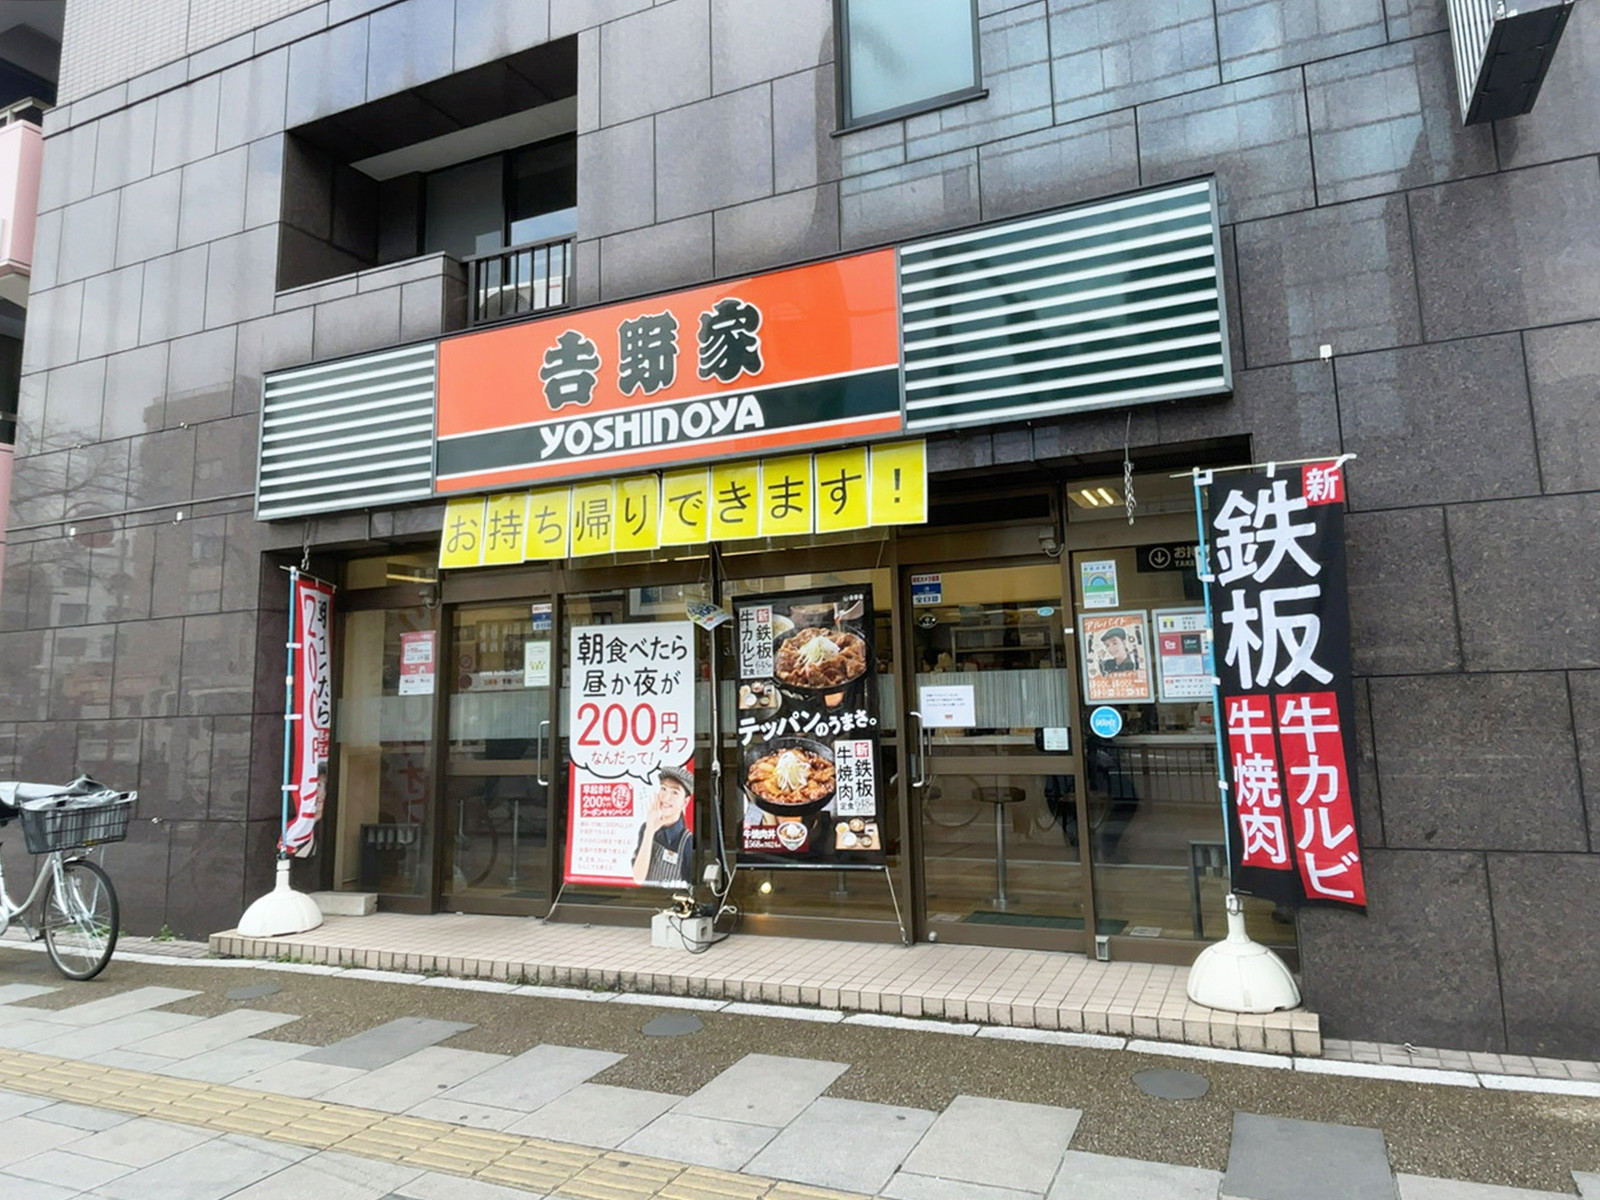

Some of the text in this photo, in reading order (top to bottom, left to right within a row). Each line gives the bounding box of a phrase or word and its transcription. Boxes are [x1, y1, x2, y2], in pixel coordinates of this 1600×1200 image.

[540, 395, 765, 460] YOSHINOYA
[1305, 466, 1338, 502] 新
[1213, 480, 1335, 690] 鉄板
[577, 633, 688, 666] 朝食べたら
[741, 609, 755, 668] 牛カルビ
[756, 624, 772, 659] 鉄板
[583, 667, 681, 697] 昼か夜が
[660, 736, 689, 753] オフ
[738, 708, 878, 746] テッパンのうまさ。
[591, 750, 655, 766] なんだって!
[837, 746, 854, 801] 牛焼肉
[855, 759, 873, 798] 鉄板
[1228, 698, 1286, 864] 牛焼肉
[1280, 695, 1359, 899] 牛カルビ
